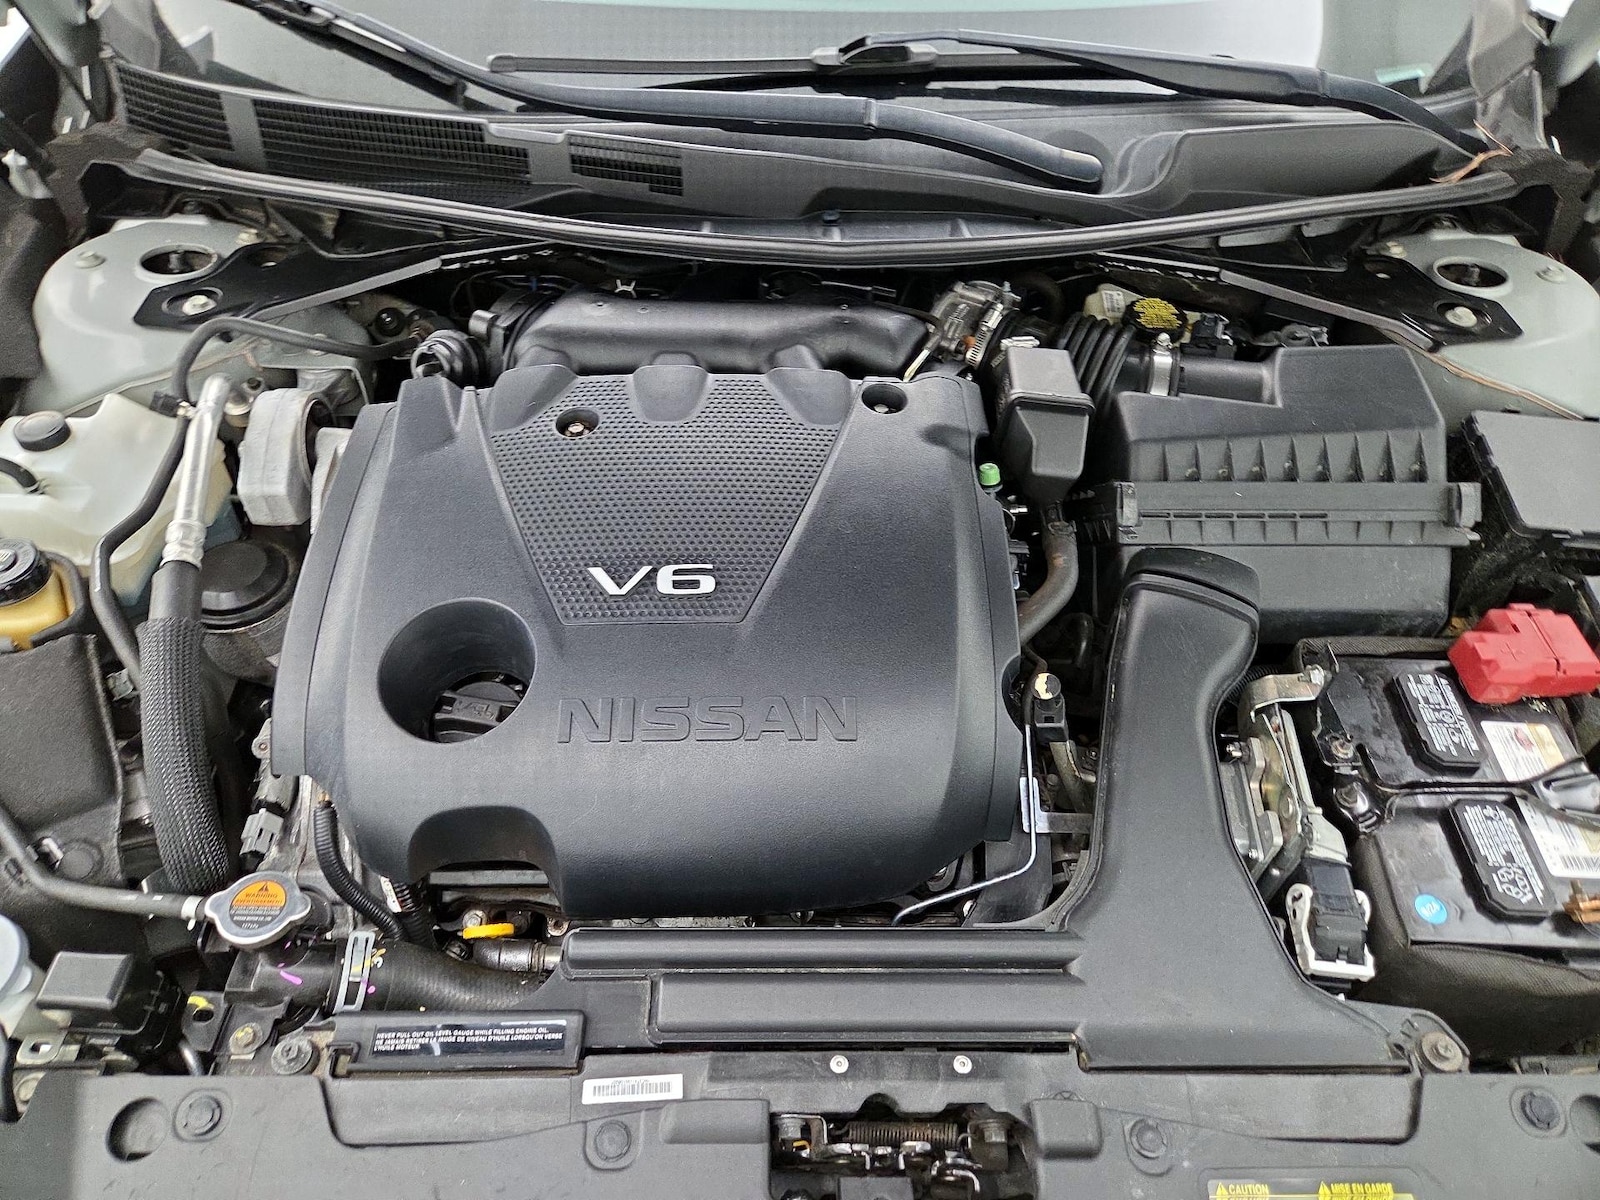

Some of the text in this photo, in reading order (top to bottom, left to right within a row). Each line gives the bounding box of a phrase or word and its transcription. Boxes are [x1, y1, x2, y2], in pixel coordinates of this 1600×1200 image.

[587, 563, 716, 597] V6
[557, 696, 858, 744] NISSAN
[376, 1032, 396, 1040] NEVER
[396, 1031, 411, 1039] PULL
[411, 1030, 425, 1038] OUT
[424, 1030, 435, 1038] OIL
[435, 1029, 452, 1037] LEVEL
[475, 1028, 493, 1036] WHILE
[438, 1035, 456, 1043] JAUGE
[466, 1034, 487, 1042] NIVEAU
[488, 1034, 510, 1042] D'HUILE
[510, 1033, 544, 1041] LORSQU'ON
[1228, 1183, 1270, 1195] CAUTION
[1330, 1182, 1394, 1194] MISE EN GARDE
